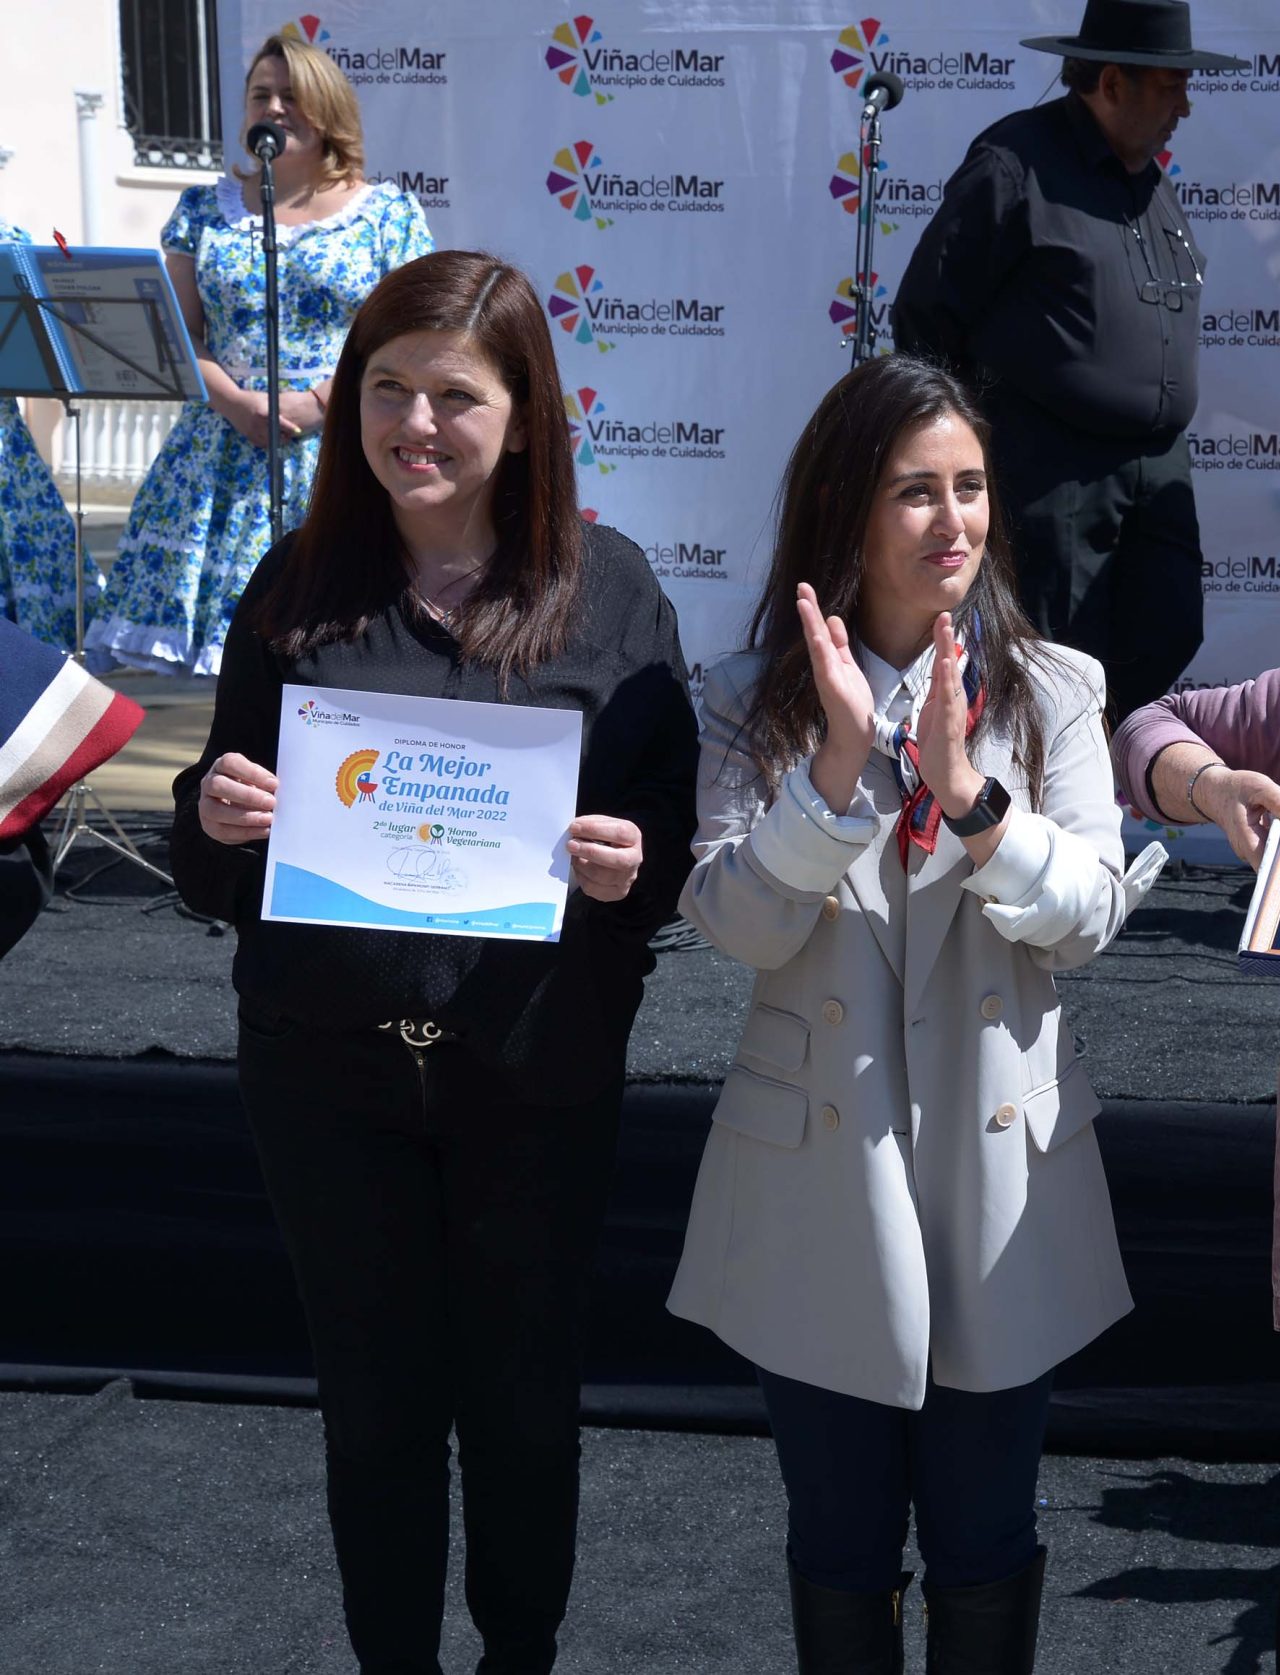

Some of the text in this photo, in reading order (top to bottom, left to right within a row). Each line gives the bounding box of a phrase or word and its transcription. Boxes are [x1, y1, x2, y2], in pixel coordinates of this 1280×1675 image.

[326, 48, 446, 71] iñadelMar
[584, 49, 725, 72] ViñadelMar
[870, 52, 1016, 76] ViñadelMar
[348, 72, 448, 87] cipio de Cuidados
[590, 74, 726, 89] Municipio de Cuidados
[903, 77, 1016, 92] icipio de Cuidados
[1186, 81, 1229, 95] nicipio
[1231, 80, 1248, 93] de
[584, 174, 724, 198] ViñadelMar
[590, 199, 725, 214] Municipio de Cuidados
[874, 203, 935, 218] Municipio
[1185, 209, 1228, 223] nicipio
[1230, 209, 1246, 221] de
[584, 298, 725, 322] ViñadelMar
[592, 323, 725, 338] Municipio de Cuidados
[1228, 335, 1245, 346] de
[586, 419, 725, 445] ViñadelMar
[593, 445, 726, 459] Municipio de Cuidados
[1192, 458, 1225, 472] icipio
[1227, 458, 1244, 470] de
[645, 542, 727, 566] delMar
[655, 566, 728, 580] de Cuidados
[1225, 580, 1241, 593] de
[394, 738, 427, 747] DIPLOMA
[440, 741, 466, 750] HONOR
[382, 751, 492, 779] La Mejor
[382, 776, 510, 805] Empanada
[378, 800, 508, 821] de Viña del Mar 2022
[388, 822, 416, 834] lugar
[447, 827, 478, 838] Horno
[446, 836, 501, 849] Vegetariana
